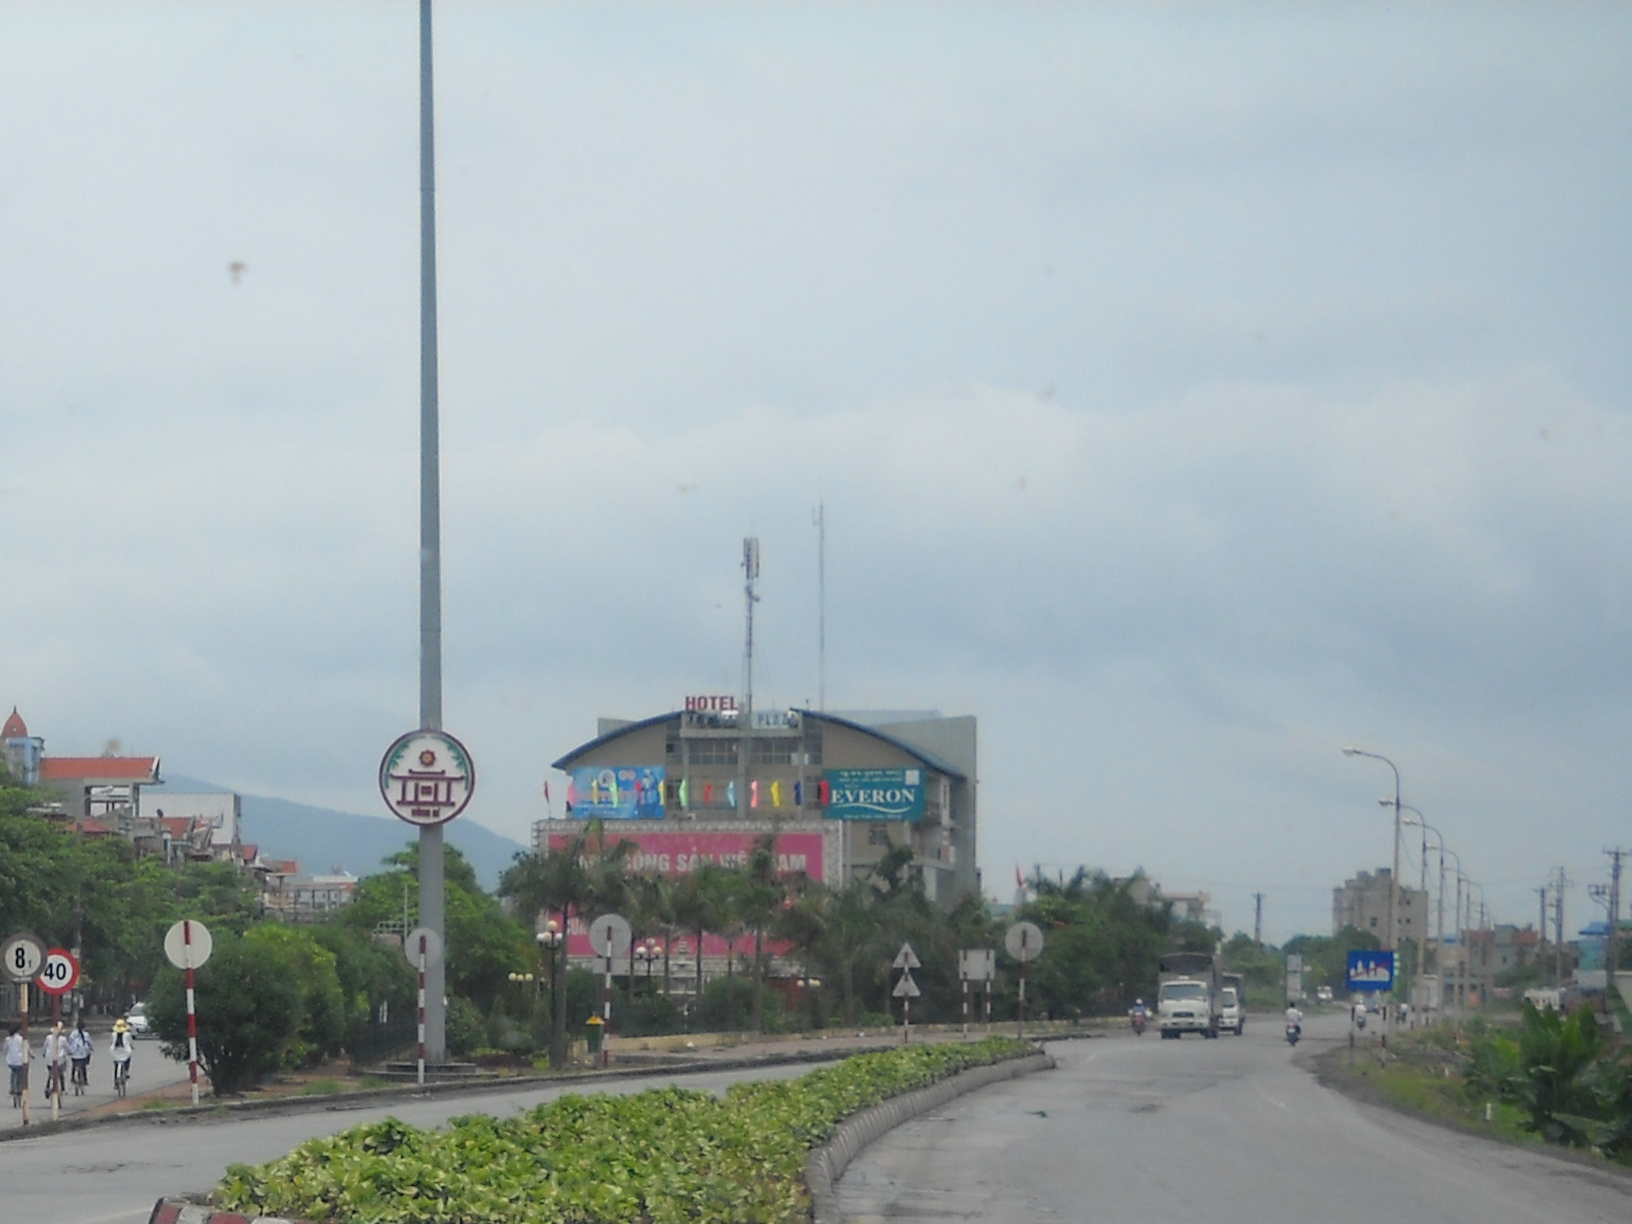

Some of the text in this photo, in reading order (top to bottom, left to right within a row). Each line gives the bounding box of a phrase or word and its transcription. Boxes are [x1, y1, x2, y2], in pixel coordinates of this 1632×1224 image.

[685, 696, 738, 711] HOTEL
[831, 788, 915, 803] EVERON
[773, 854, 806, 871] AM
[15, 947, 25, 969] 8
[44, 962, 67, 980] 40
